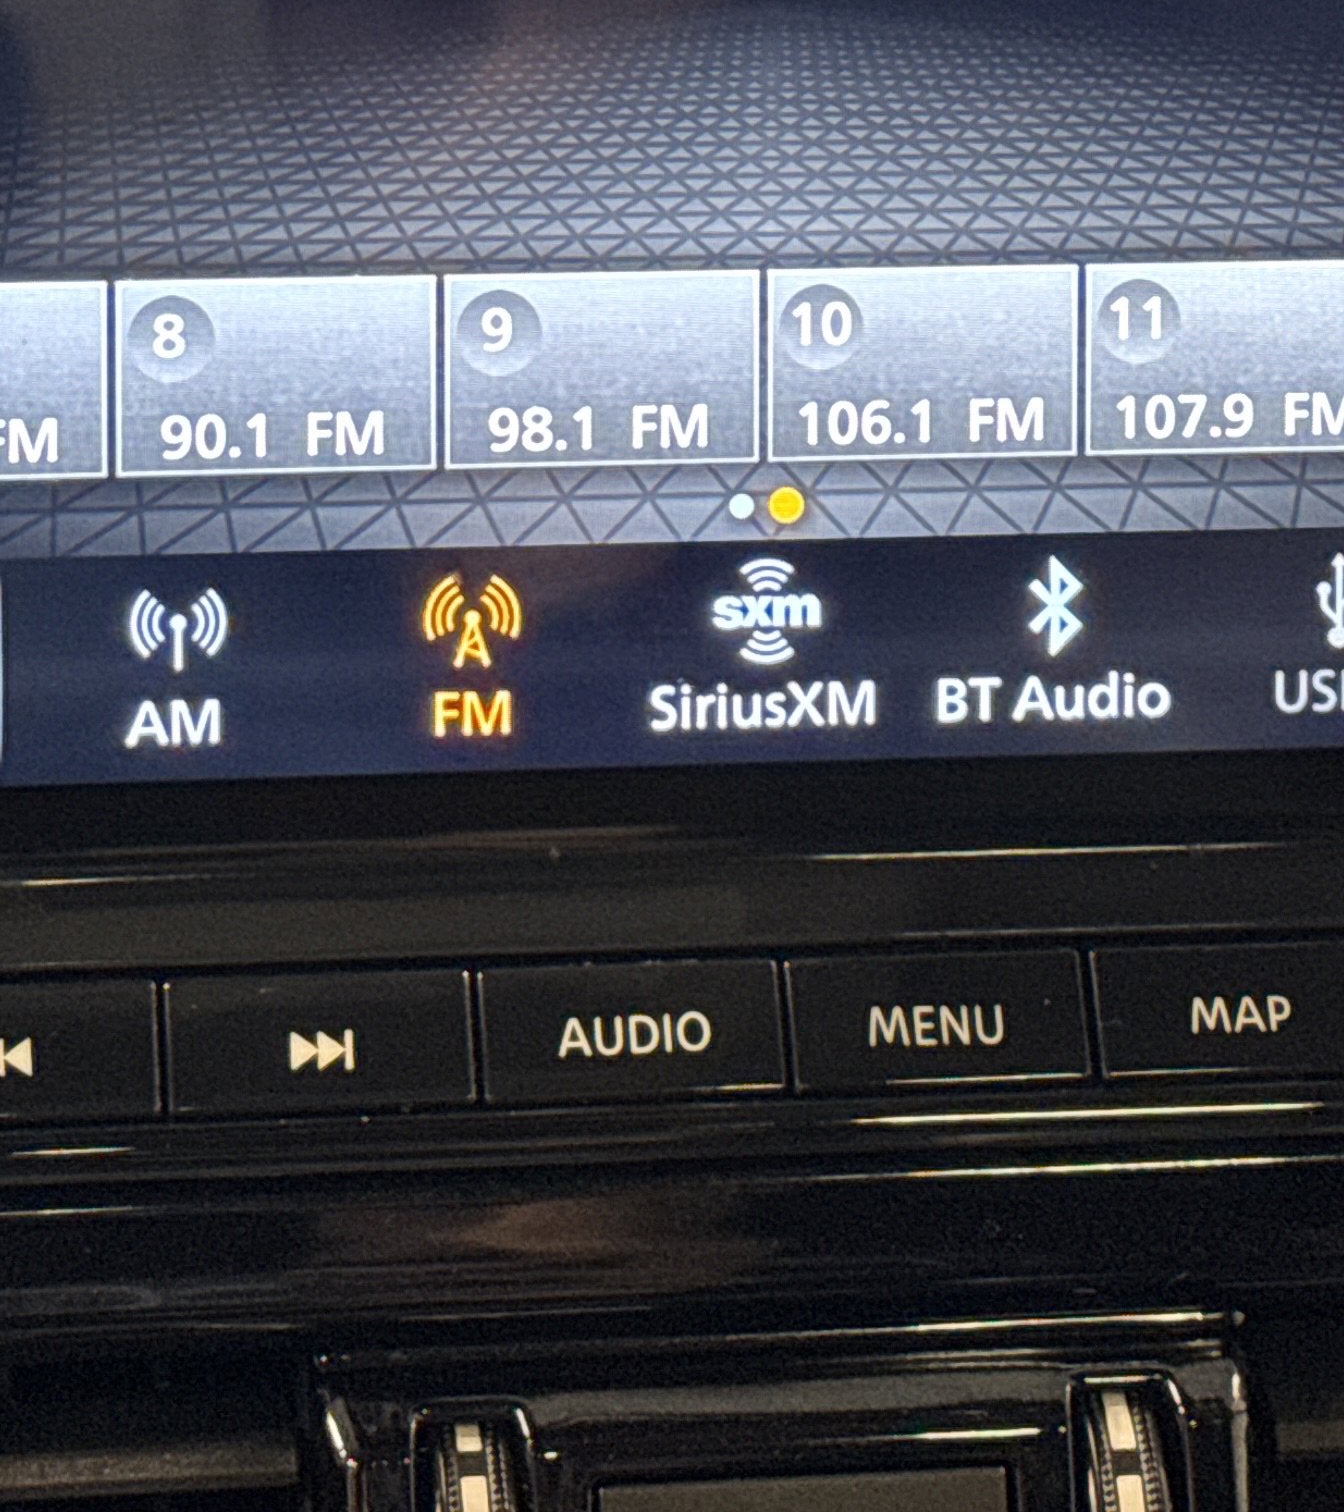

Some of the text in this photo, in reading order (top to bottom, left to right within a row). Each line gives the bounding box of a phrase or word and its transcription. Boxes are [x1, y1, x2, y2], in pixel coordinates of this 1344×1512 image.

[152, 314, 185, 359] 8
[479, 307, 513, 352] 9
[791, 300, 852, 346] 10
[1109, 295, 1165, 341] 11
[159, 411, 385, 459] 90.1 FM
[488, 404, 708, 453] 98.1 FM
[799, 398, 1044, 446] 106.1 FM
[1116, 393, 1253, 440] 107.9
[712, 587, 821, 629] sxm
[432, 690, 513, 738] FM
[649, 676, 877, 732] SiriusXM
[936, 672, 1171, 722] BT Audio
[125, 699, 220, 749] AM
[558, 1009, 712, 1059] AUDIO
[868, 1002, 1005, 1049] MENU
[1190, 993, 1290, 1037] MAP
